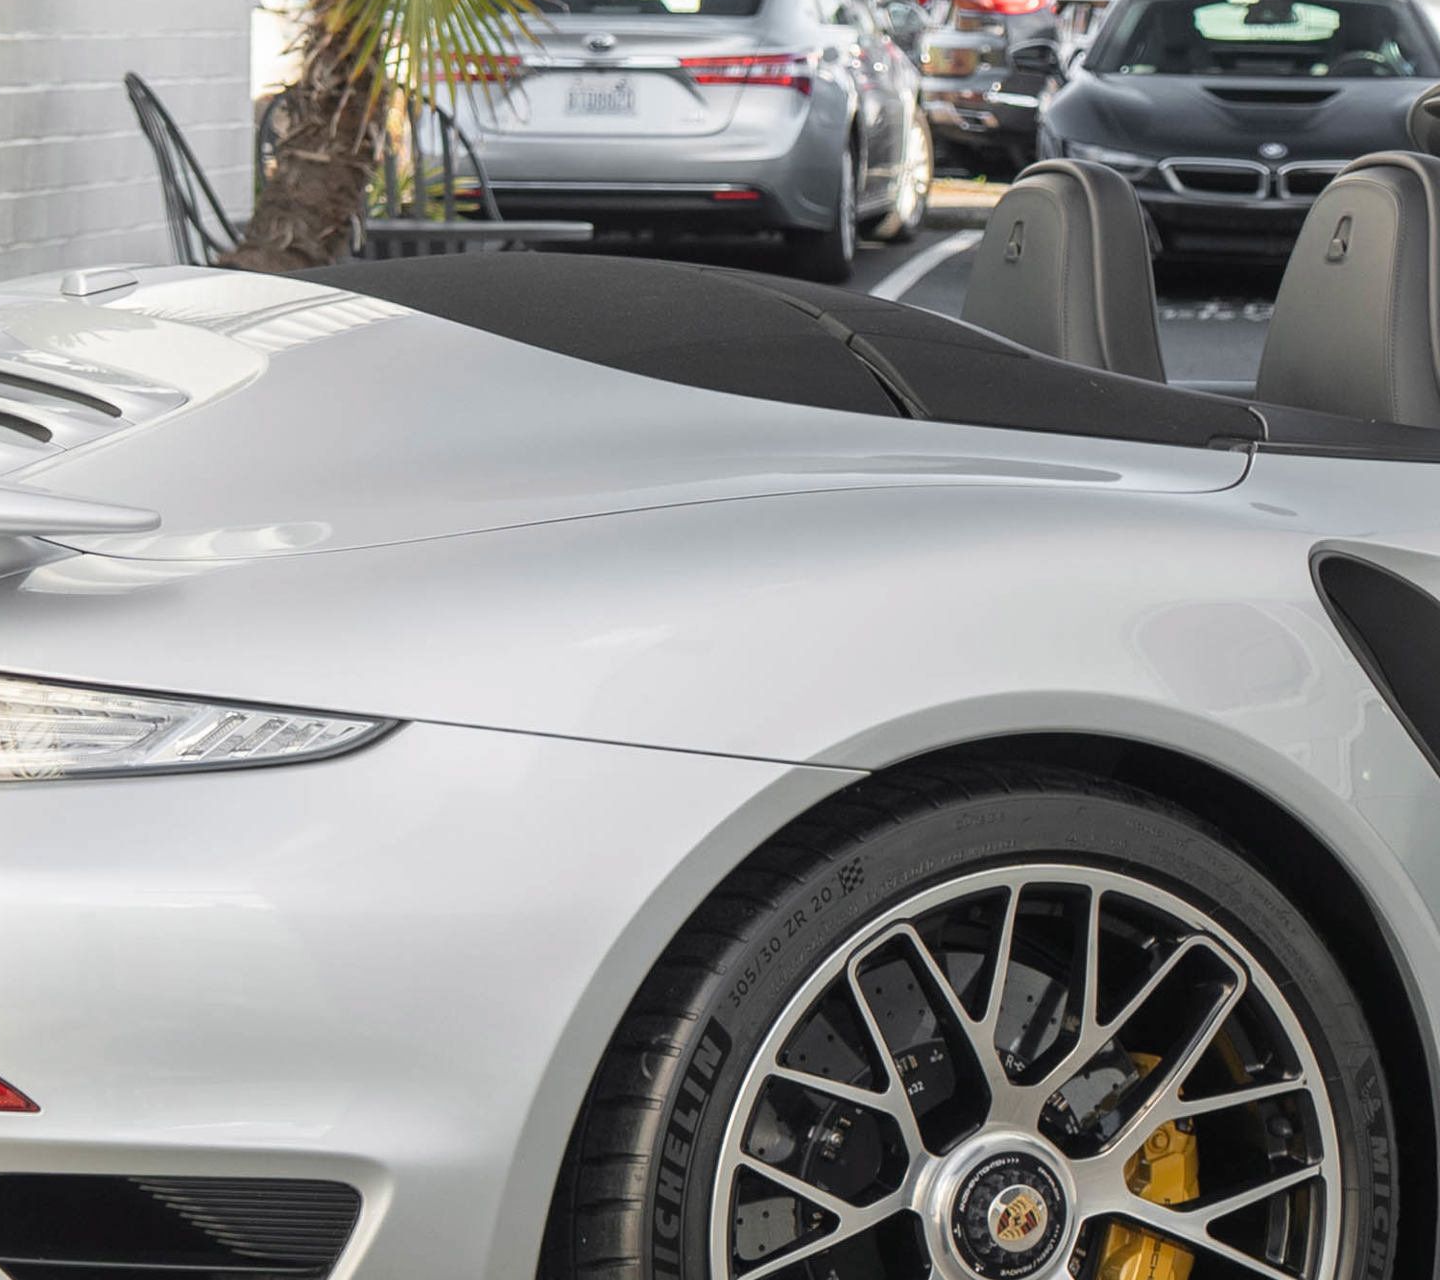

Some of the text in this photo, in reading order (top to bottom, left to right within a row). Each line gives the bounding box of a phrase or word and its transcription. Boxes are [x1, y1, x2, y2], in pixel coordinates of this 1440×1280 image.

[727, 935, 782, 1008] 305/30
[783, 909, 808, 938] ZR
[810, 886, 833, 913] 20
